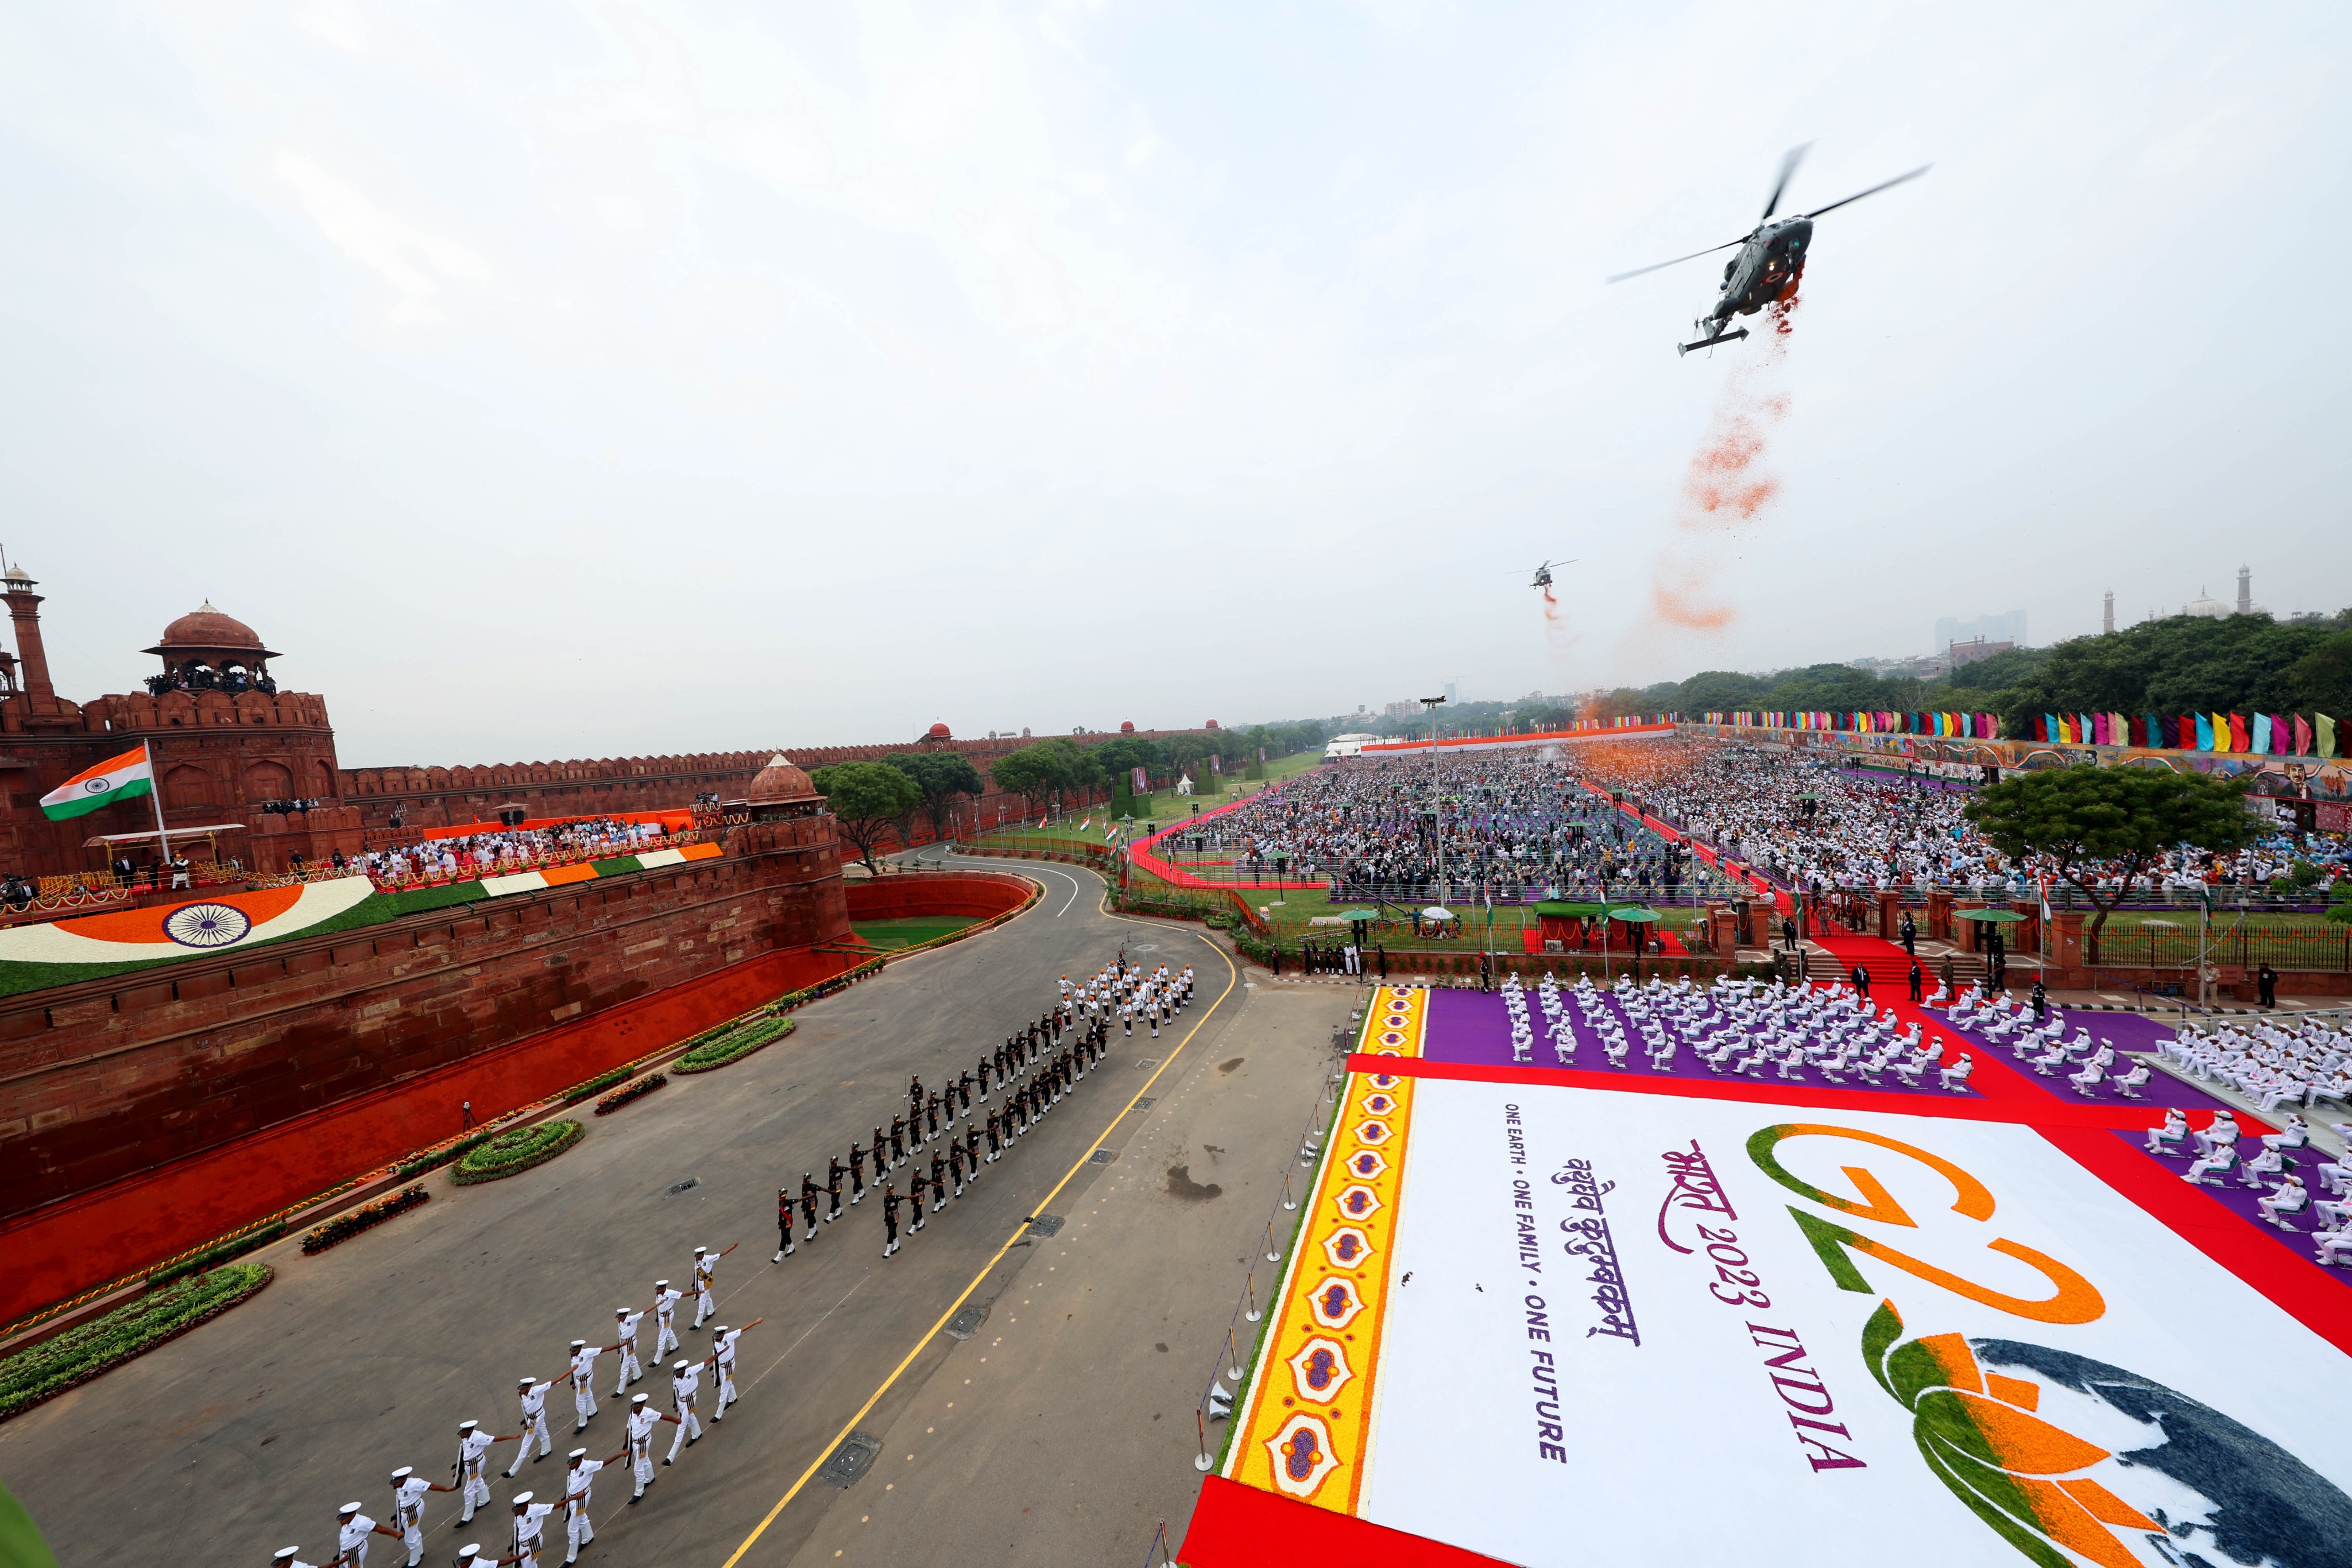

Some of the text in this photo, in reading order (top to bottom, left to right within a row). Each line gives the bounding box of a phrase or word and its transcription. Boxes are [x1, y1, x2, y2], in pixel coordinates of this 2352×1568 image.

[1505, 1104, 1567, 1464] ONE EARTH ONE FAMILY ONE FUTURE
[1658, 1139, 1867, 1473] भारत 2023 INDIA
